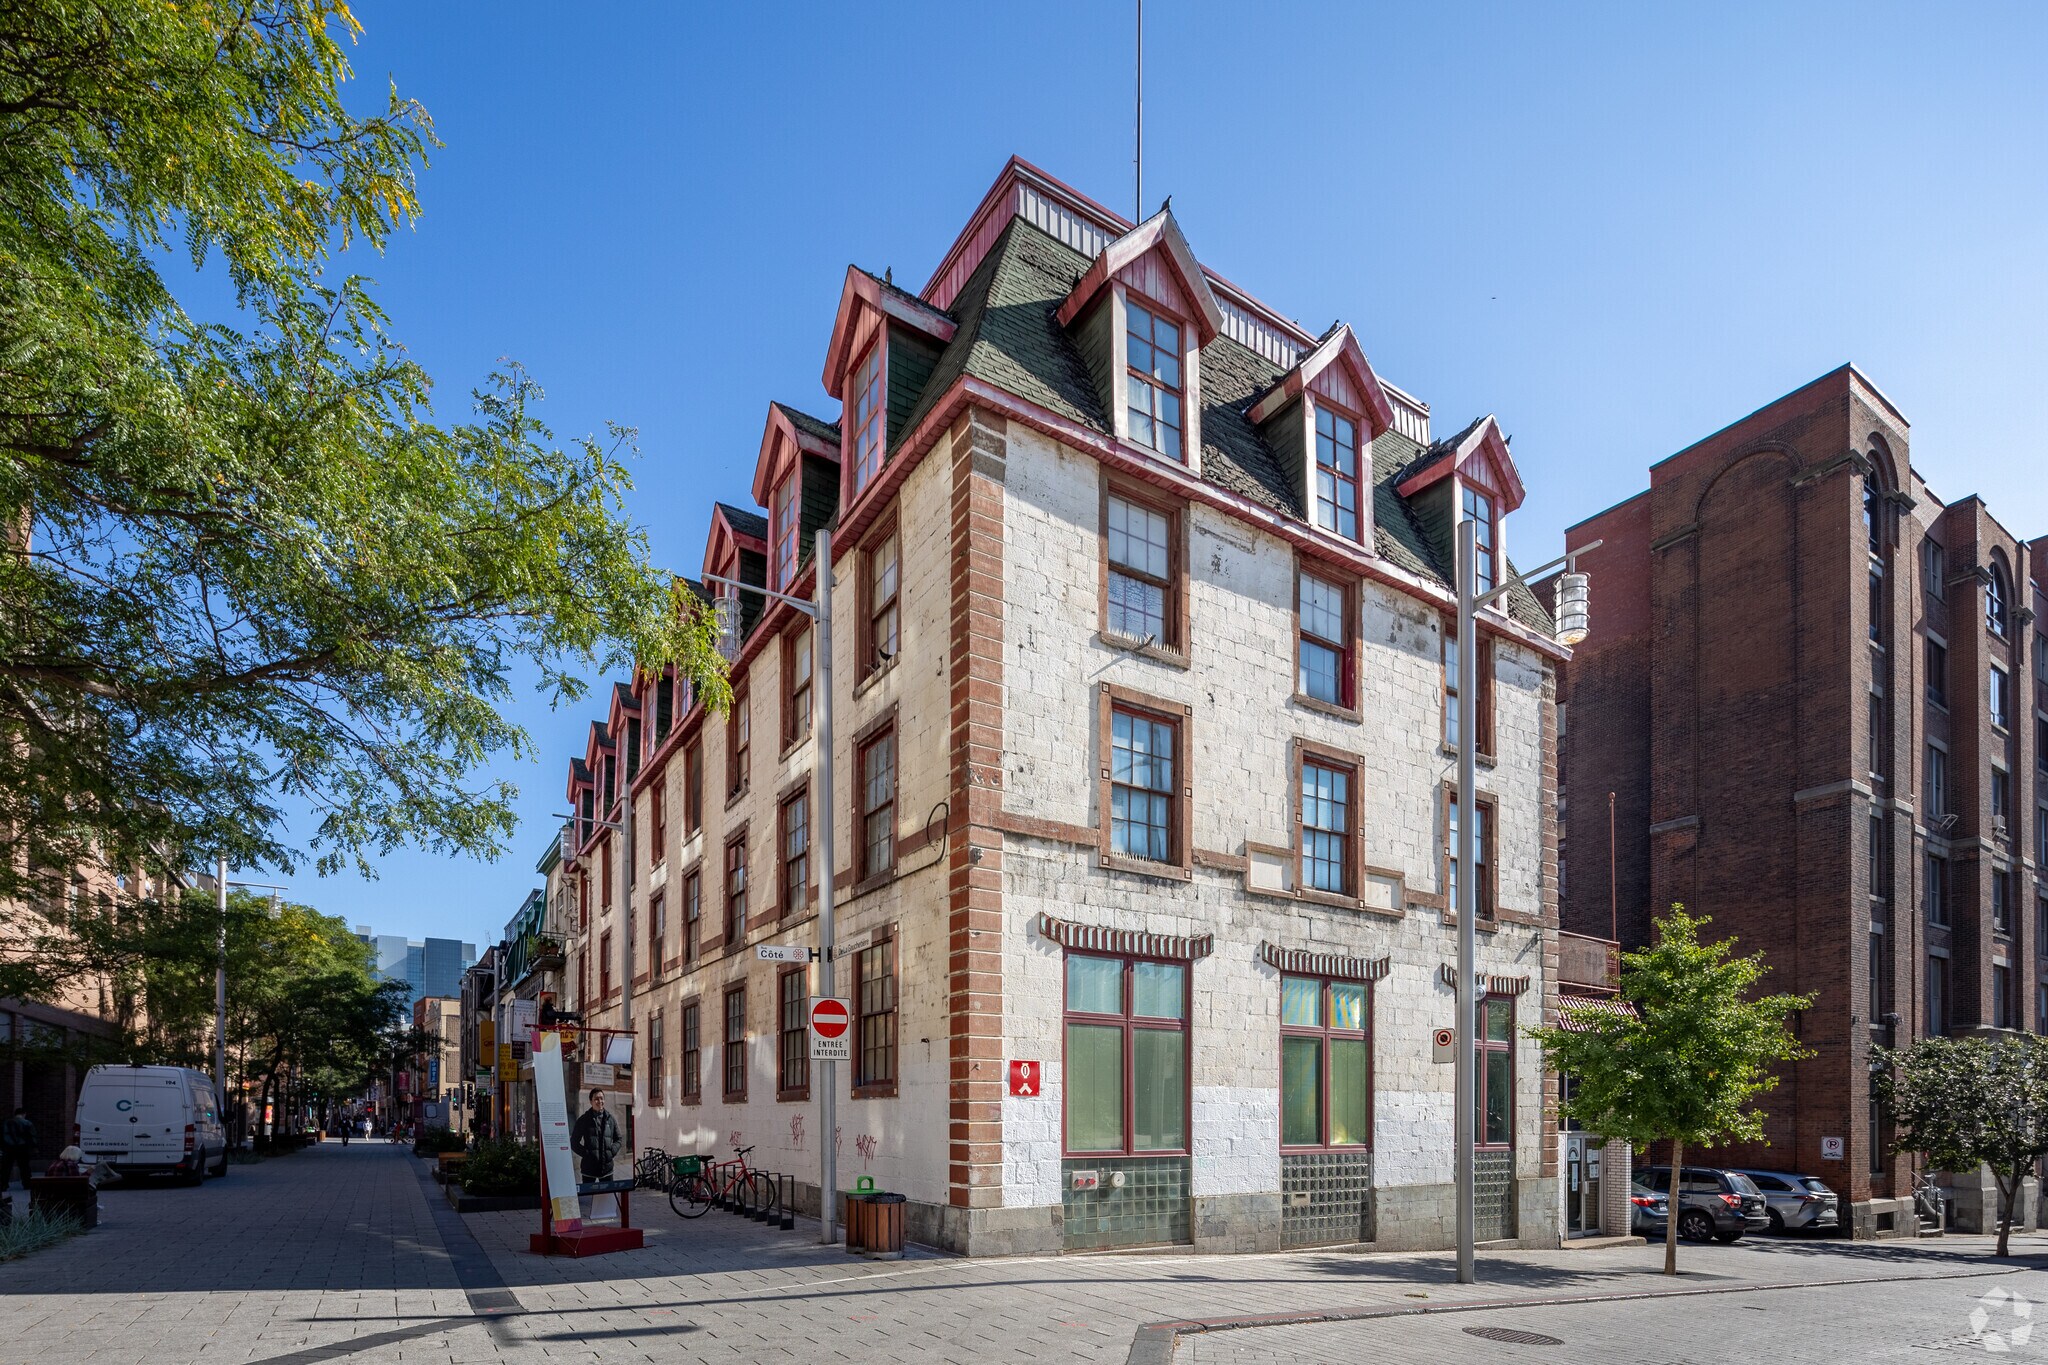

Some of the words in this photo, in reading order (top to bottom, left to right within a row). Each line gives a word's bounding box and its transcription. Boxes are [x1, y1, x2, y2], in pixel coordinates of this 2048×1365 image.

[760, 950, 784, 959] Côté
[818, 1039, 843, 1048] ENTRÉE
[813, 1049, 848, 1057] INTERDITE
